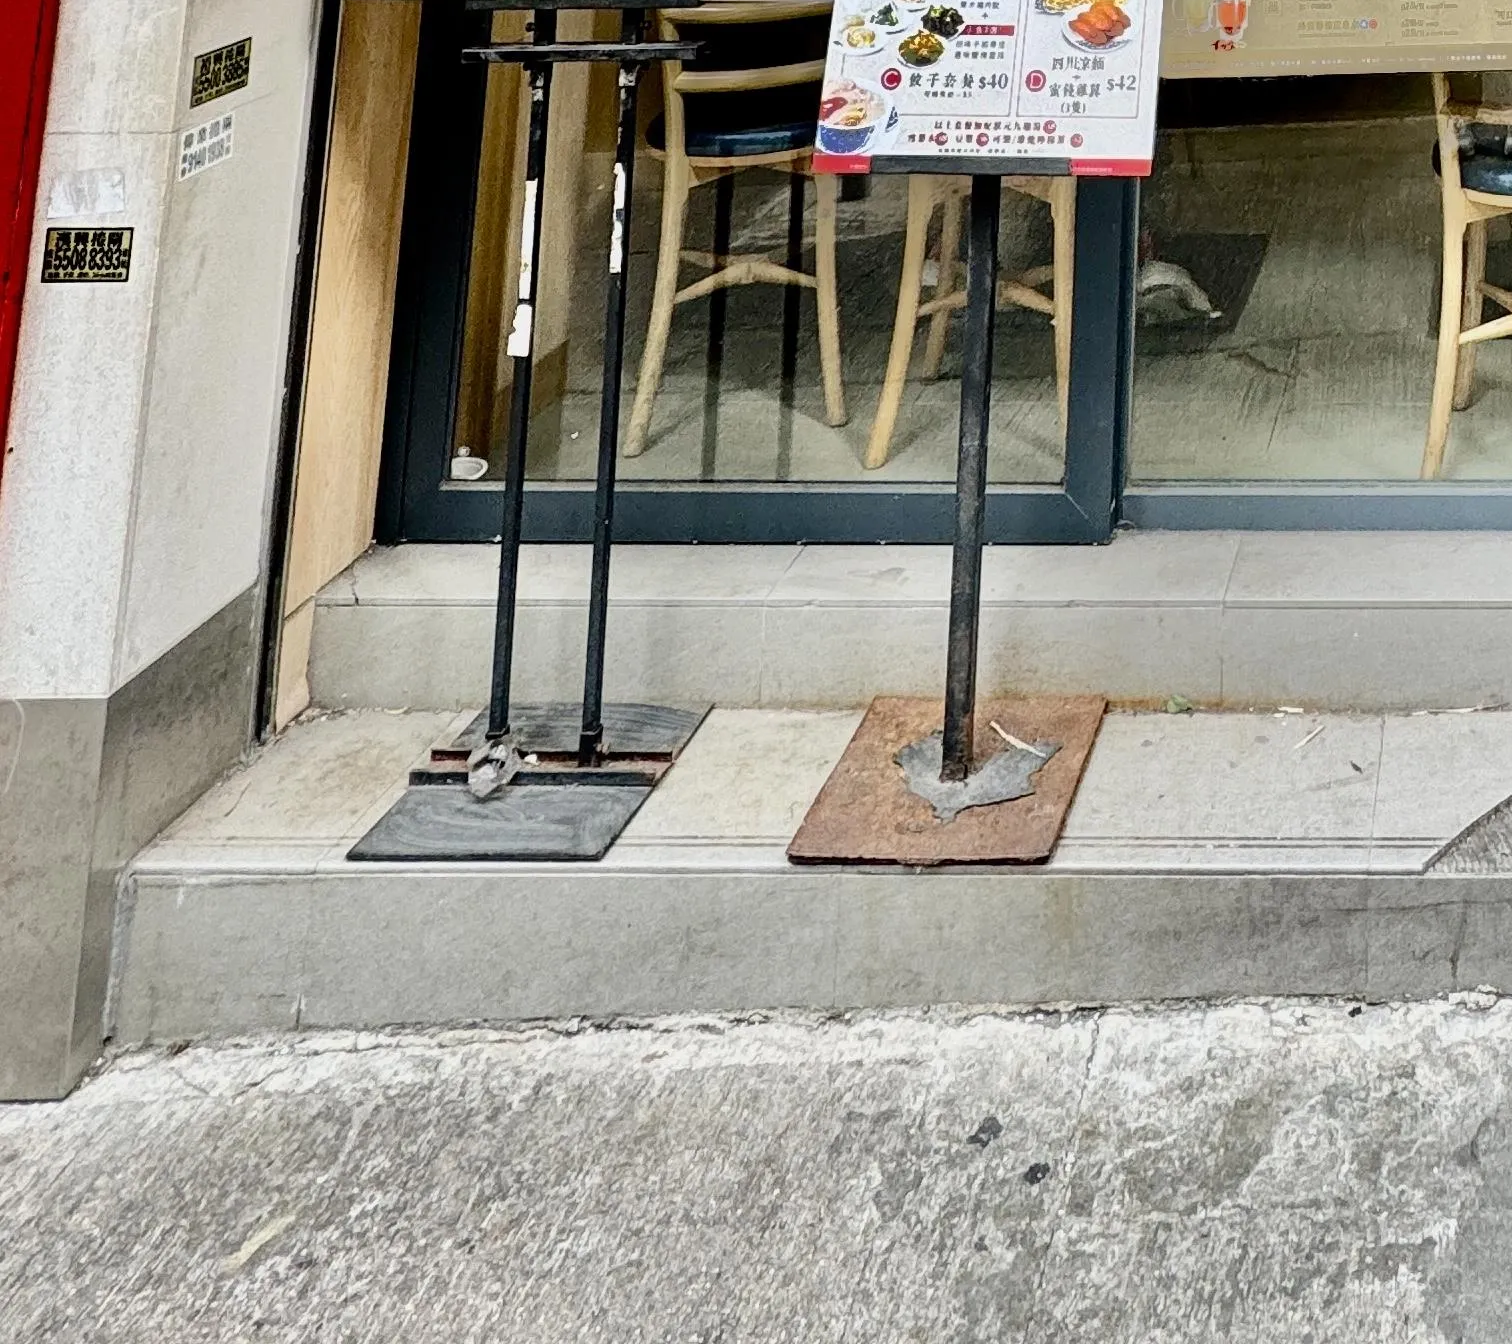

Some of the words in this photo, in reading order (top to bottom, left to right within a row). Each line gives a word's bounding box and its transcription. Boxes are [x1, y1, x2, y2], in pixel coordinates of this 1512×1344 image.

[884, 72, 898, 88] C
[979, 74, 1008, 91] $40
[1029, 74, 1042, 89] D
[1107, 75, 1137, 91] $42
